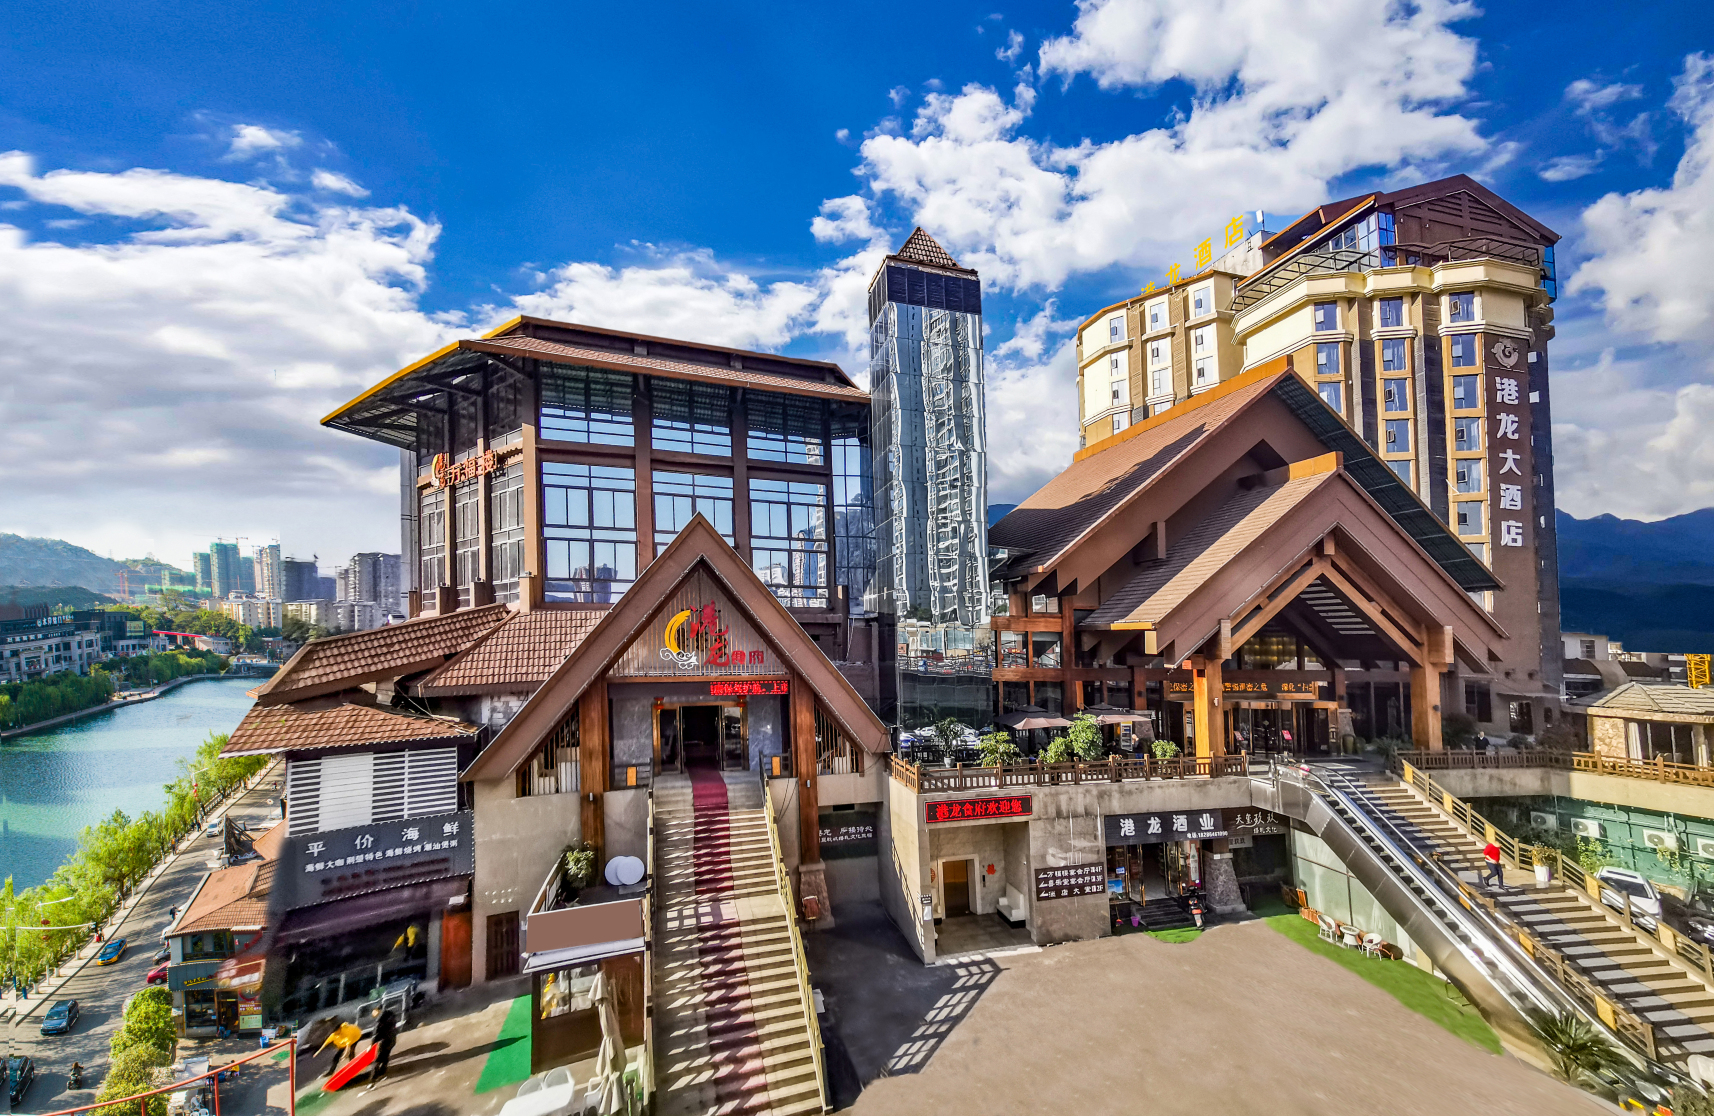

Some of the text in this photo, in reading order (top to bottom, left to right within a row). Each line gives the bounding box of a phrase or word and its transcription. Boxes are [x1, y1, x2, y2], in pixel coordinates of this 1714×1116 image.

[1494, 376, 1524, 547] 港龙大酒店
[936, 798, 1023, 820] 港龙食府欢迎您
[305, 821, 460, 857] 平价海鲜
[1120, 813, 1215, 836] 港龙酒业
